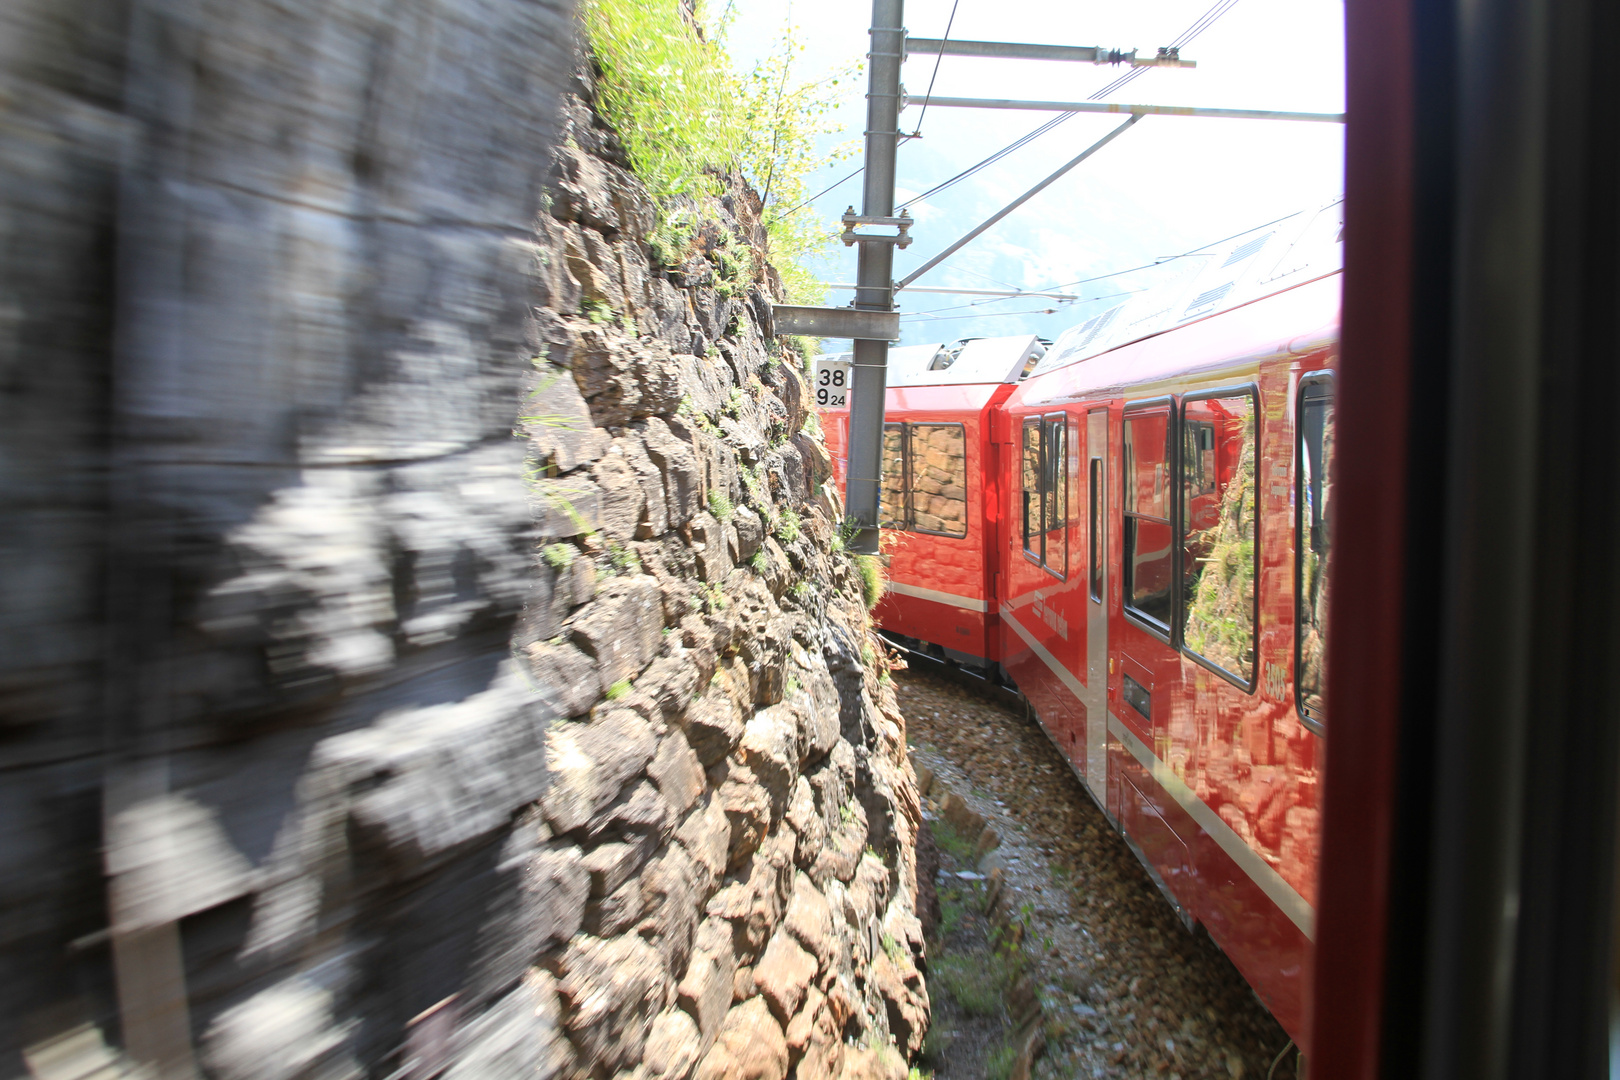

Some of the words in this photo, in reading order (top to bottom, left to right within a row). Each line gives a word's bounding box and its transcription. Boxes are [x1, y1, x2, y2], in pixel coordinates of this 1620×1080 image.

[819, 369, 845, 387] 38
[817, 388, 829, 405] 9
[830, 395, 845, 406] 24
[1265, 661, 1286, 702] 3505
